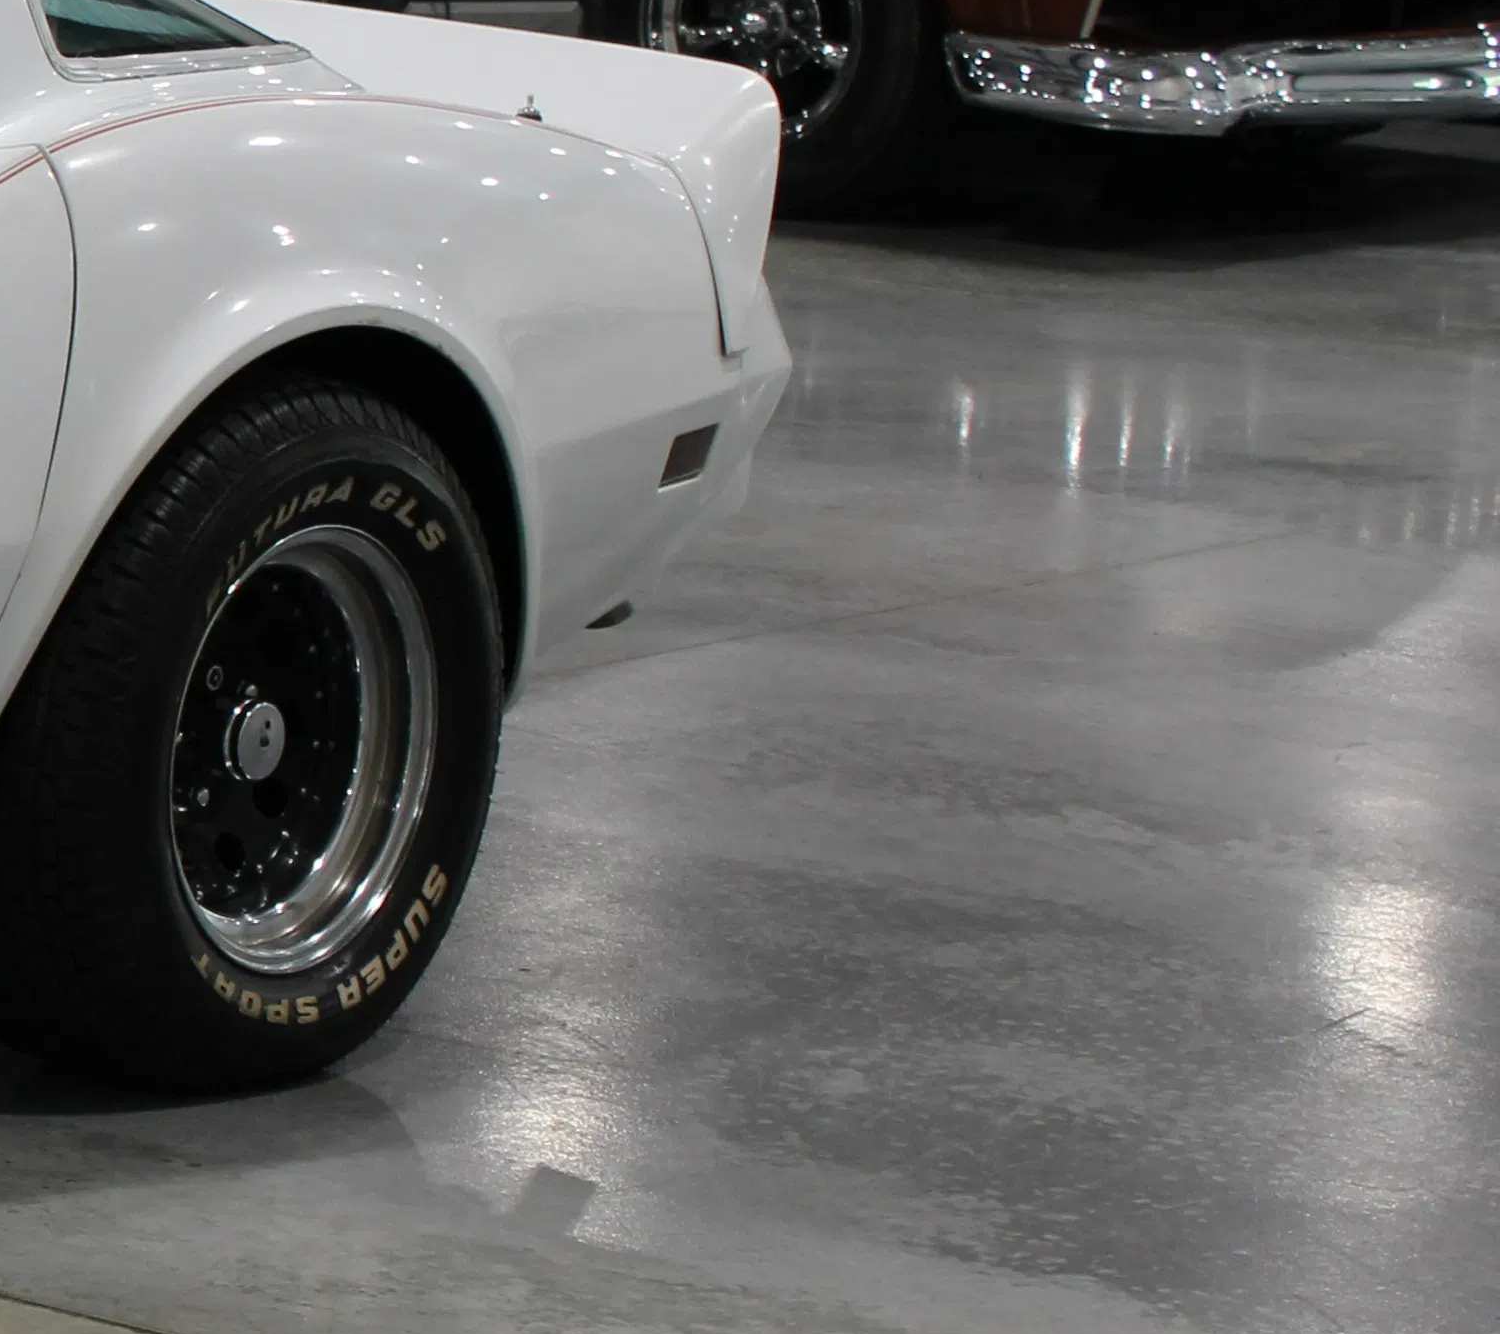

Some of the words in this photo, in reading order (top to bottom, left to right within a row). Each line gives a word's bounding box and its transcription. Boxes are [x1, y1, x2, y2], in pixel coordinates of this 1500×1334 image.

[369, 481, 448, 552] GLS
[336, 863, 449, 1011] SUPER
[190, 953, 321, 1026] SPORT
